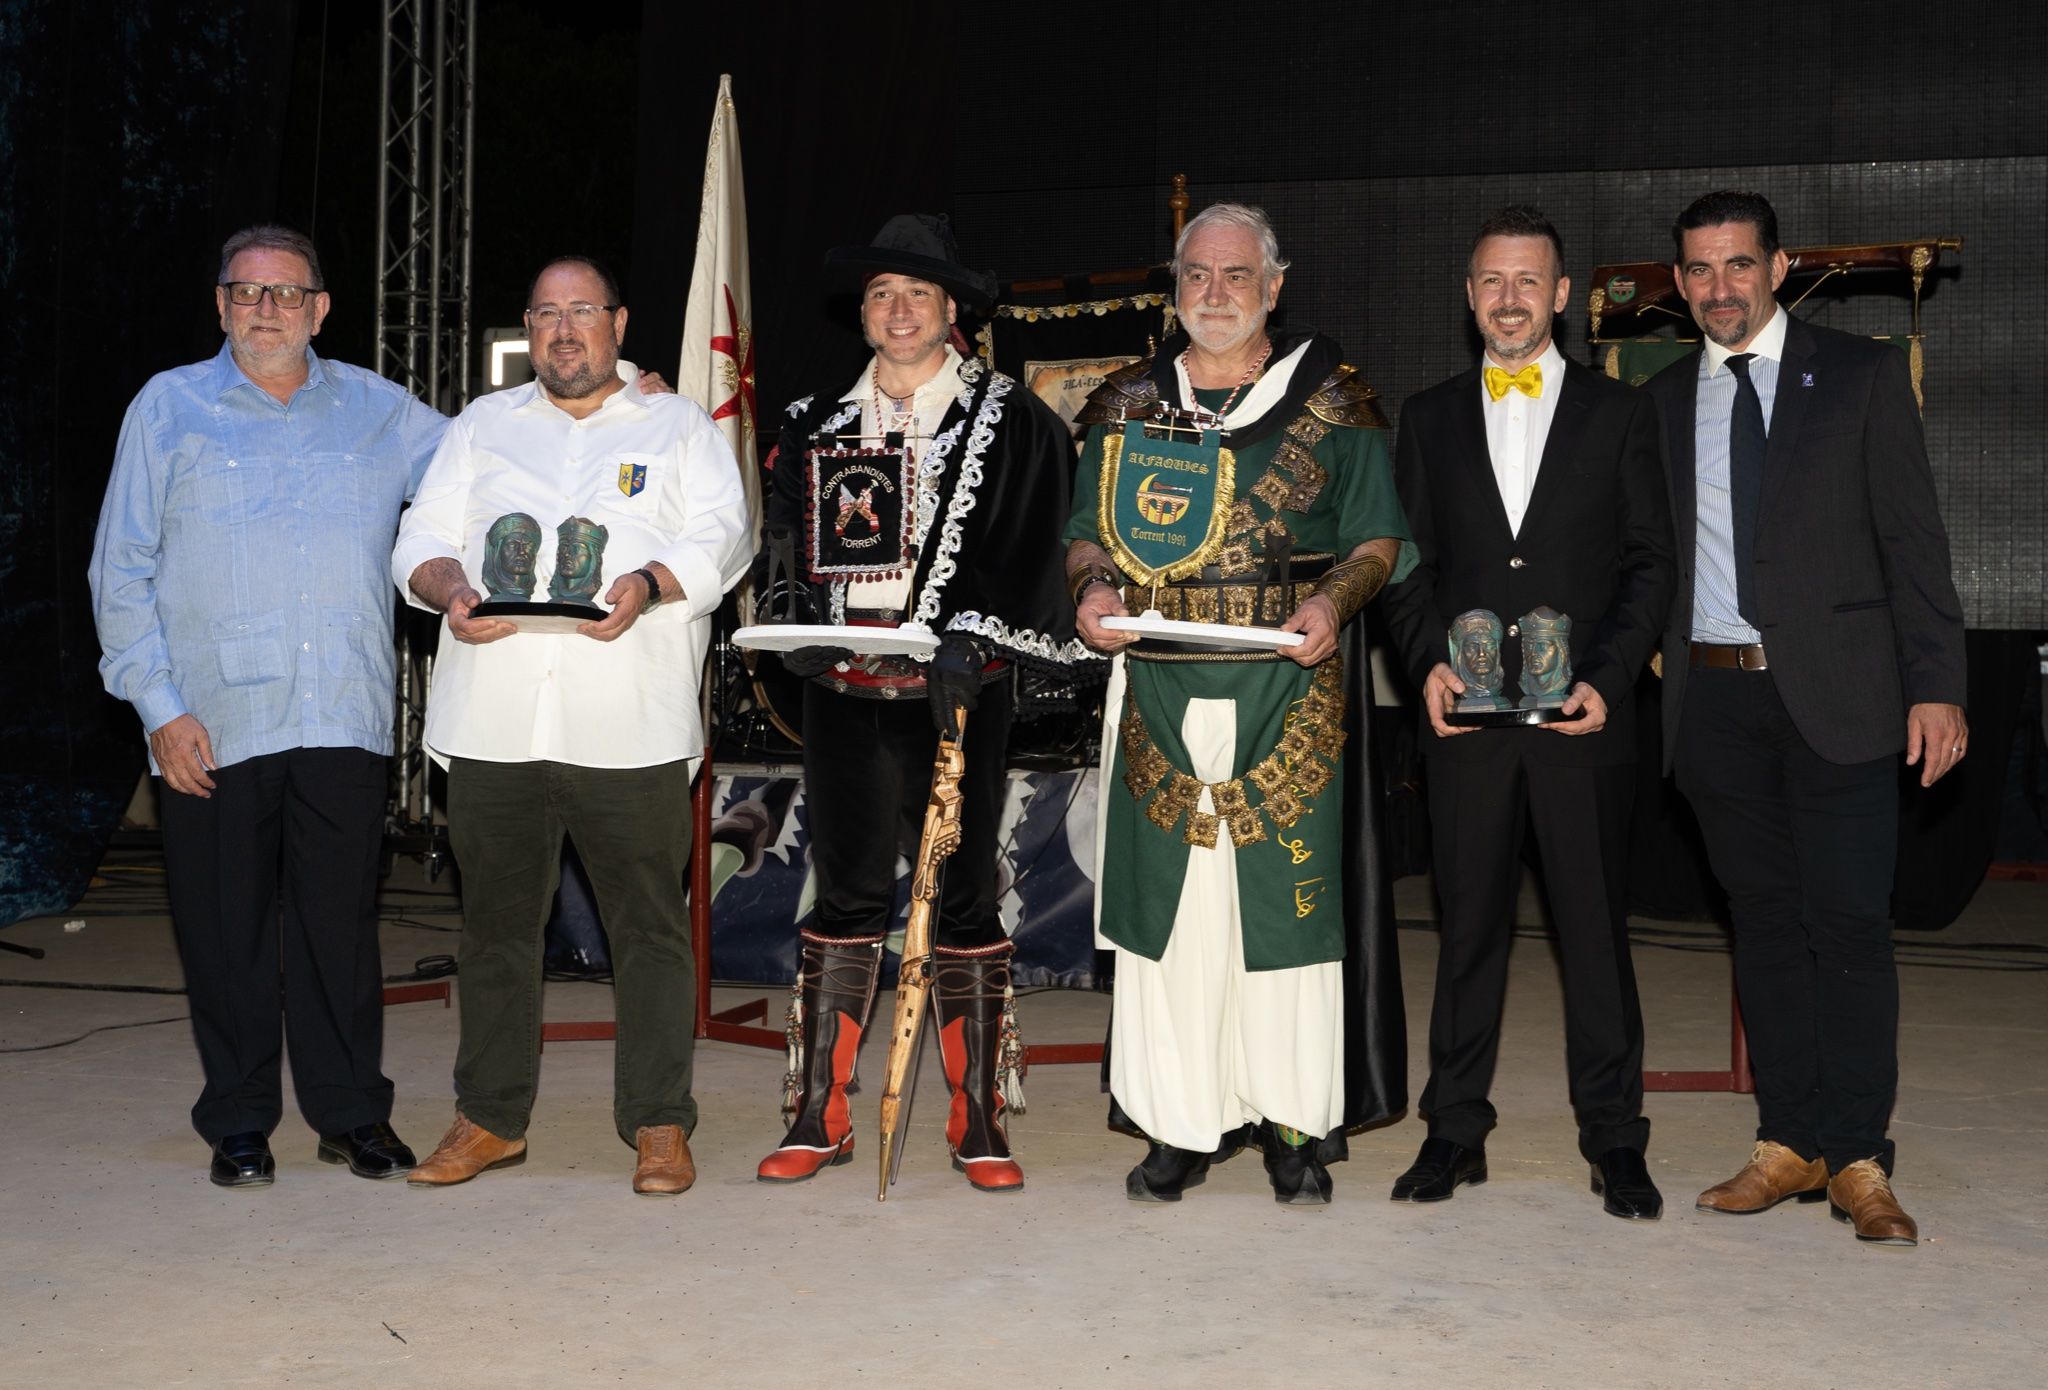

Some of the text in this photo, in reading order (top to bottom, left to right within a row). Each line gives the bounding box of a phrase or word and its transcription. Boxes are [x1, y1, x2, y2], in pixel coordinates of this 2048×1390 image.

[822, 465, 895, 500] CONTRABANDISTES
[840, 533, 882, 549] TORRENT
[1130, 527, 1187, 547] Torrent 1991
